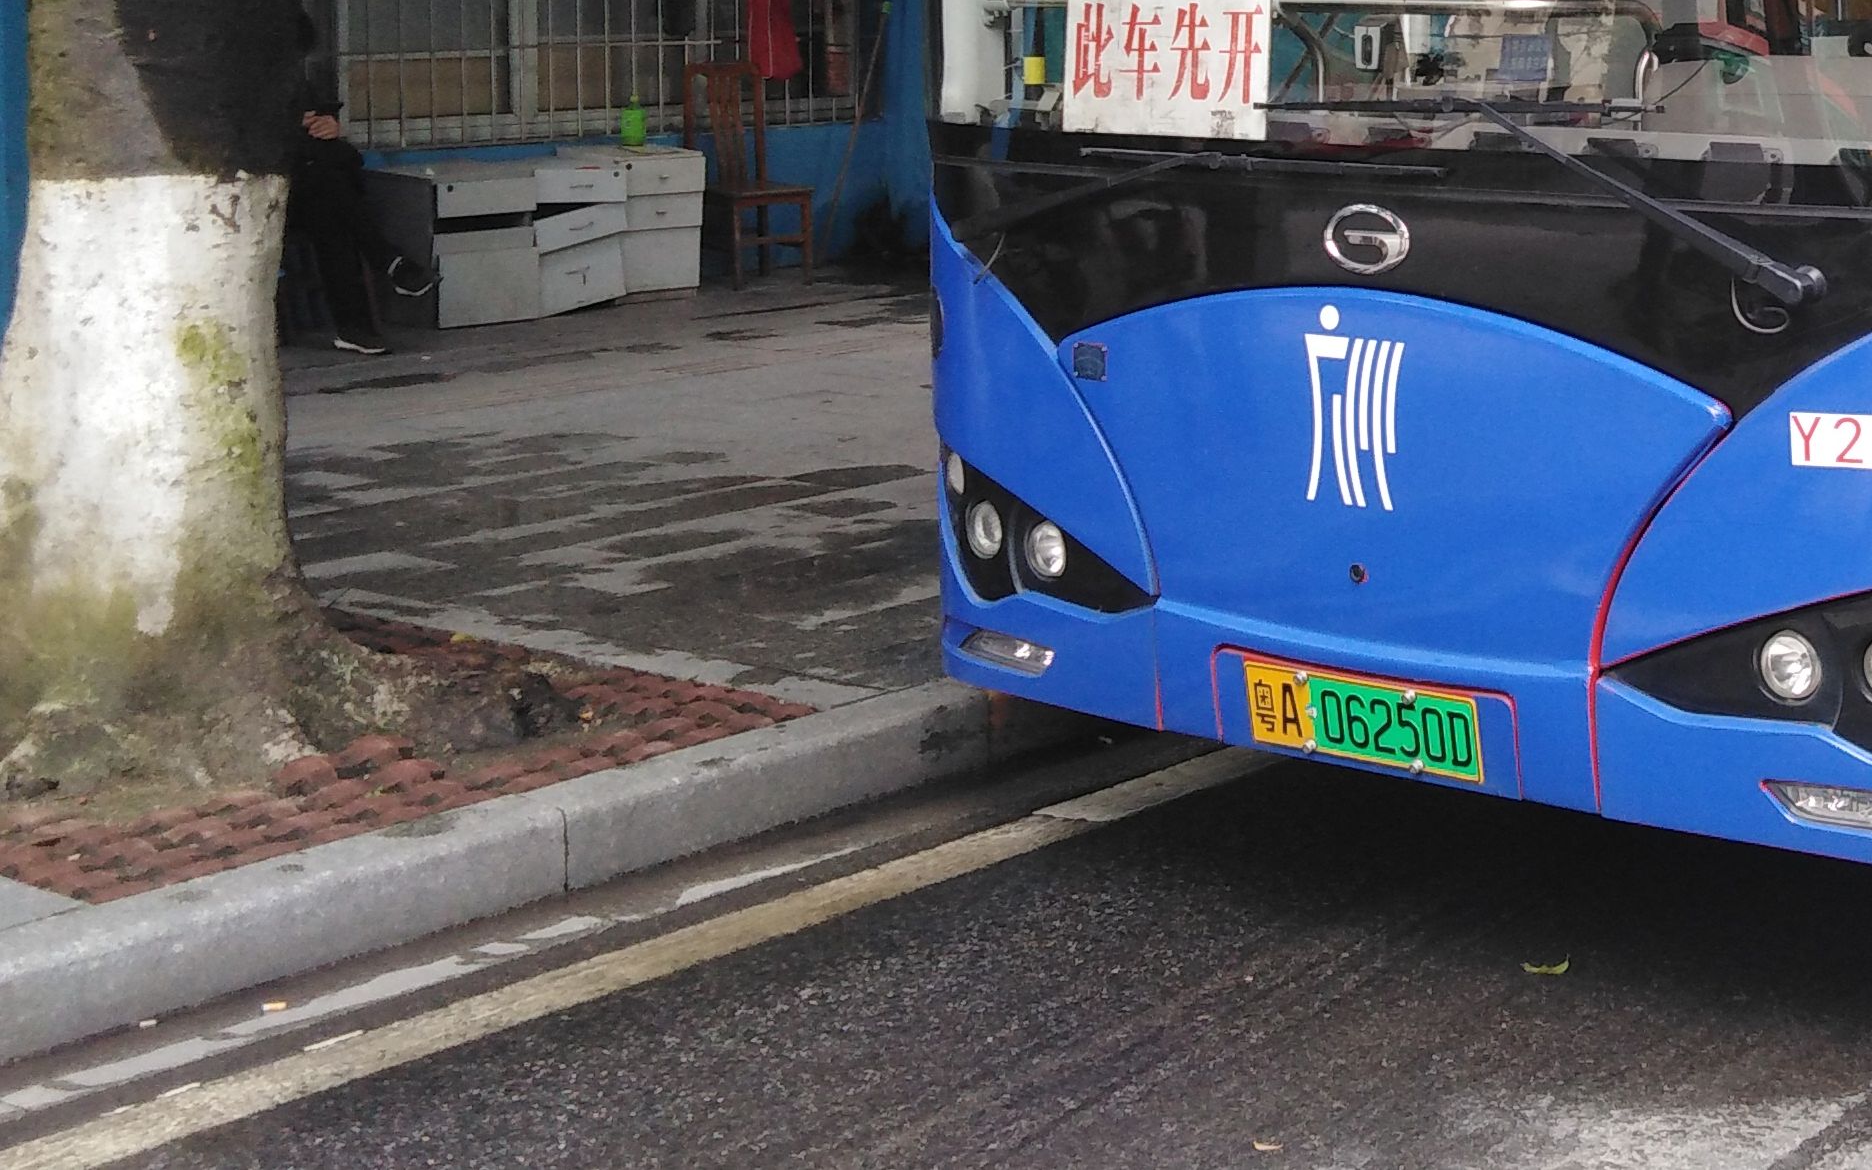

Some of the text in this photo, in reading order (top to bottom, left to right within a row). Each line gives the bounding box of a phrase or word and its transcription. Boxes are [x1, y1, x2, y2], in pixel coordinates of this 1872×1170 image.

[1072, 2, 1264, 106] 此车先开
[1254, 678, 1474, 768] 粤A 06250D
